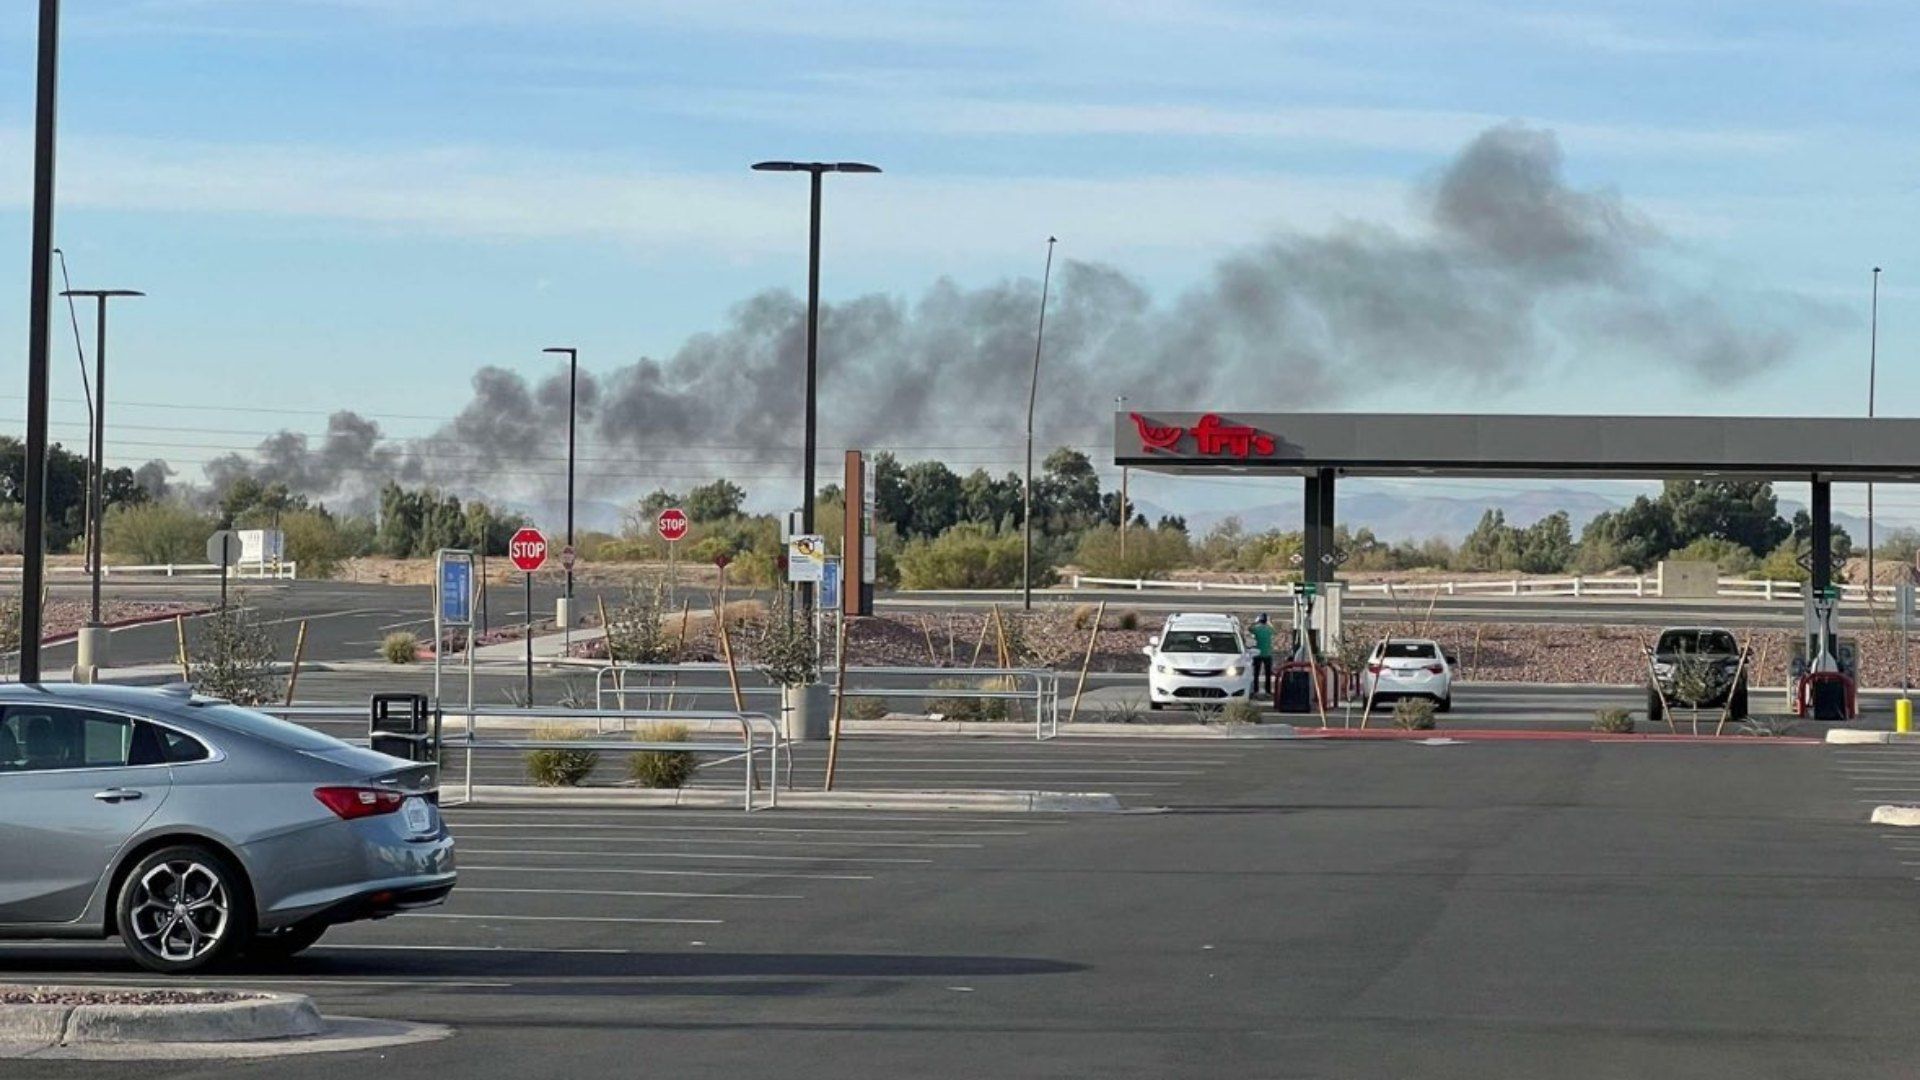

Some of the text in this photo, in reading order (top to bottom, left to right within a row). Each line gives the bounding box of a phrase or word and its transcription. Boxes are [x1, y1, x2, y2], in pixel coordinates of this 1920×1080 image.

[1190, 413, 1275, 458] fry's
[660, 518, 685, 531] STOP
[513, 542, 545, 558] STOP
